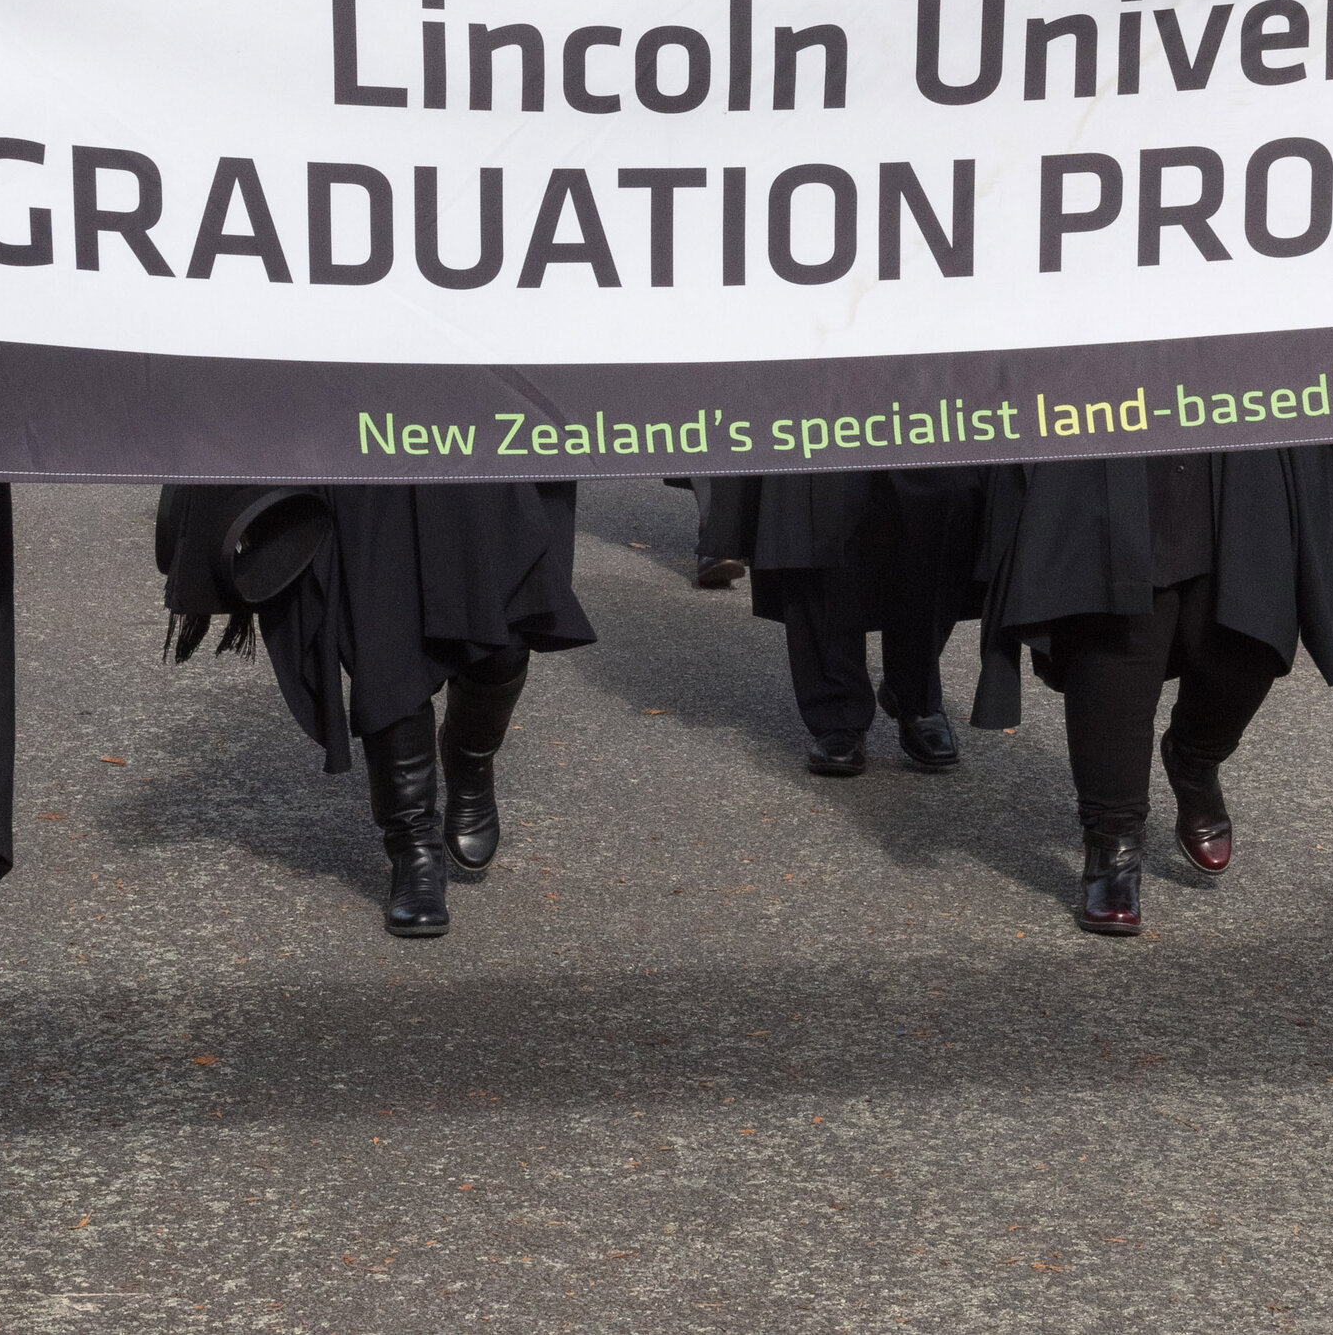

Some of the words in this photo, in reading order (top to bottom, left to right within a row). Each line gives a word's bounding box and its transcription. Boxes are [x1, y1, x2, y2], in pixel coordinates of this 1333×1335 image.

[358, 411, 476, 455] New
[494, 409, 753, 455] Zealand's
[771, 398, 1021, 459] specialist
[1037, 373, 1331, 437] land-based
